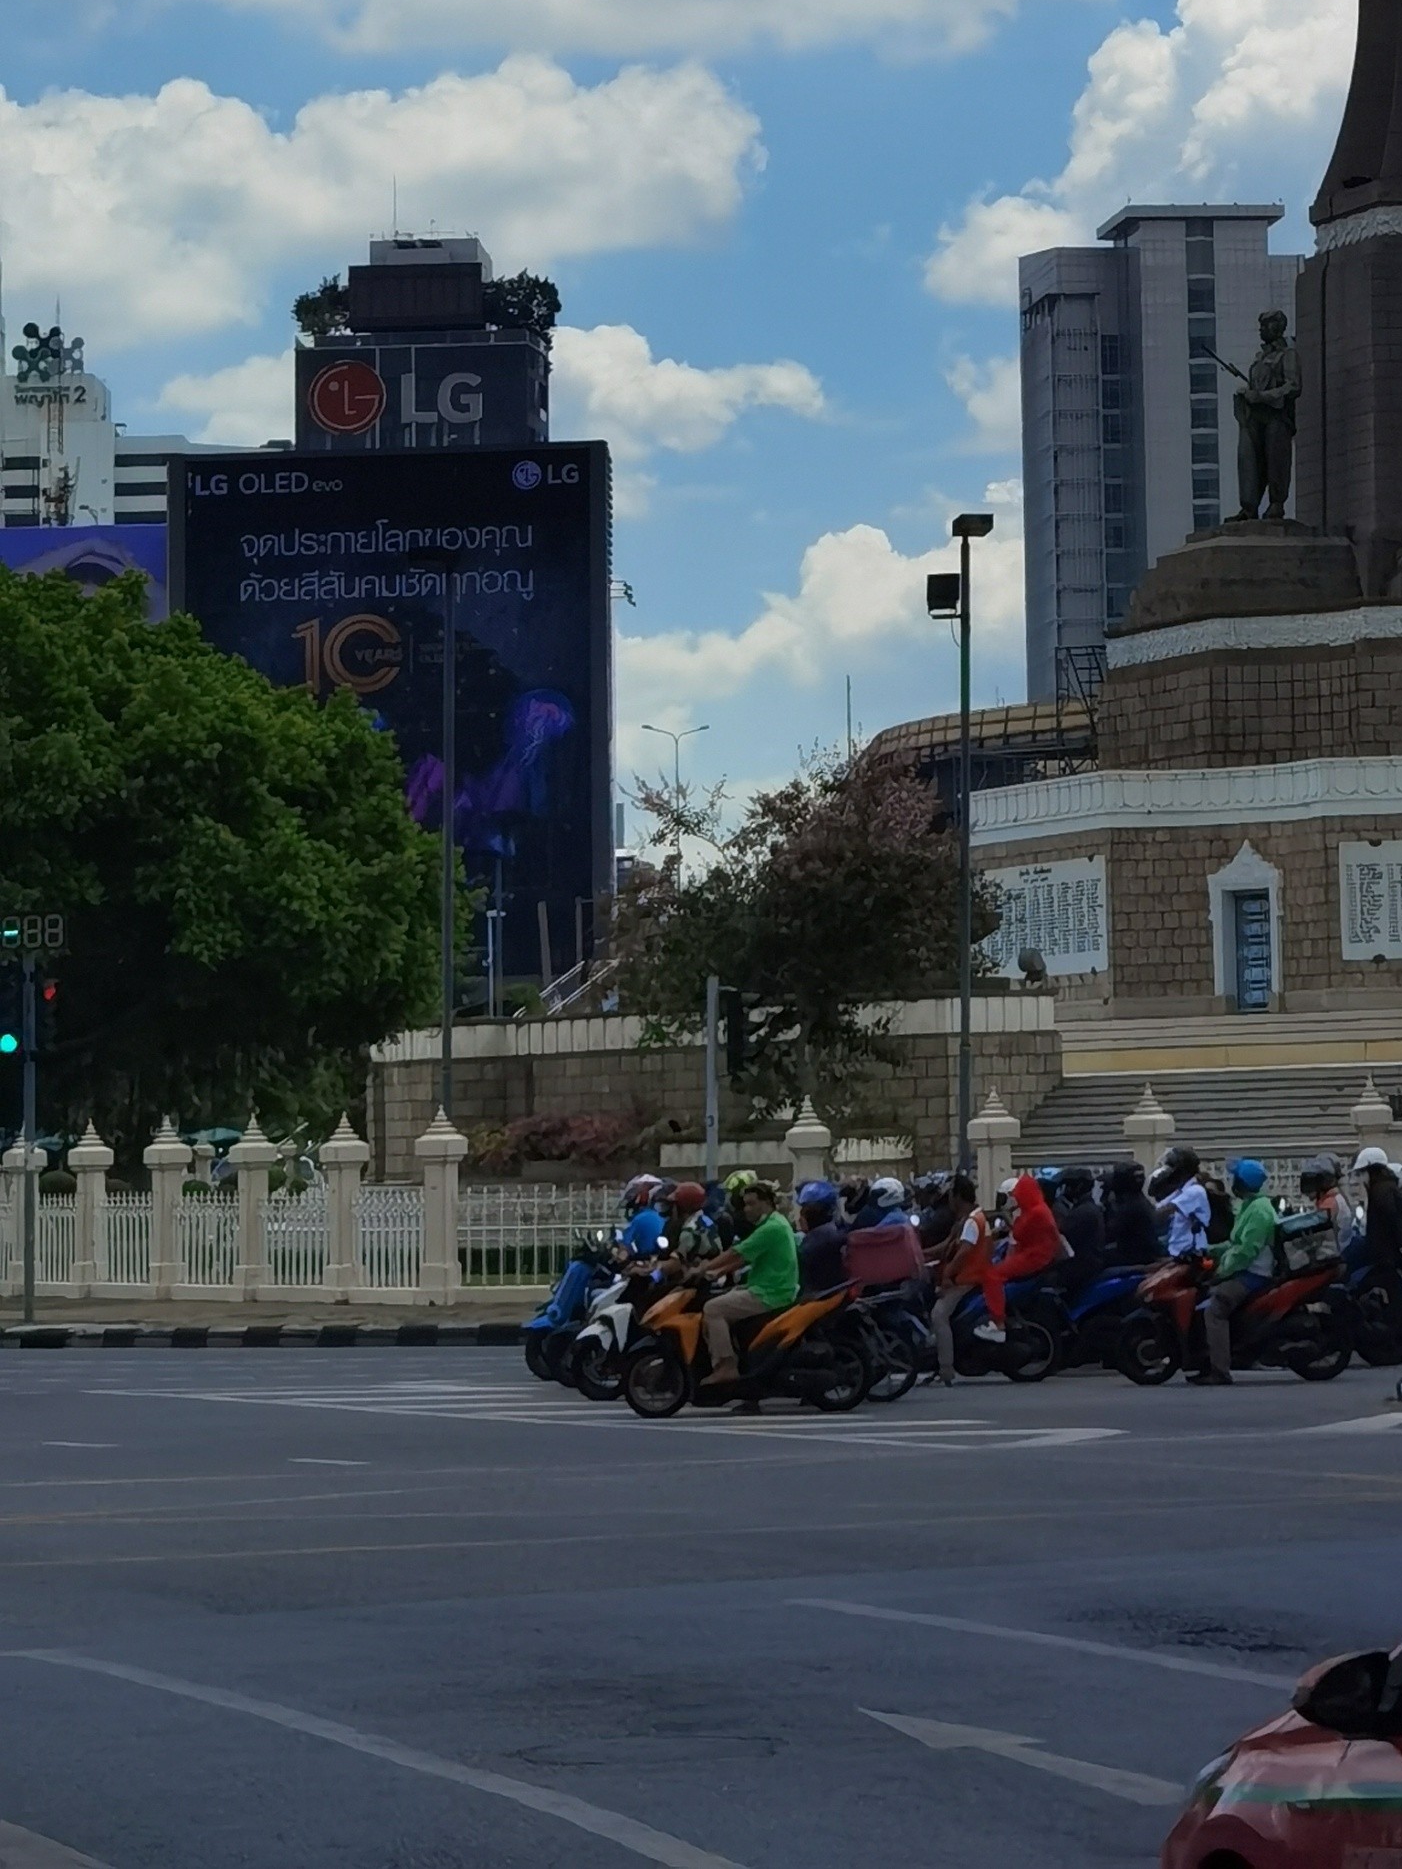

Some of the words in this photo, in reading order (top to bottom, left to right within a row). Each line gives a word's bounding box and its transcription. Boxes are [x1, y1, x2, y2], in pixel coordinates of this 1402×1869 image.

[73, 385, 87, 404] 2
[401, 372, 483, 423] LG
[195, 474, 228, 496] LG
[238, 472, 309, 495] OLED
[312, 479, 343, 492] evo
[547, 463, 579, 484] LG
[239, 519, 533, 565] จุดประกายโลกของคุณ
